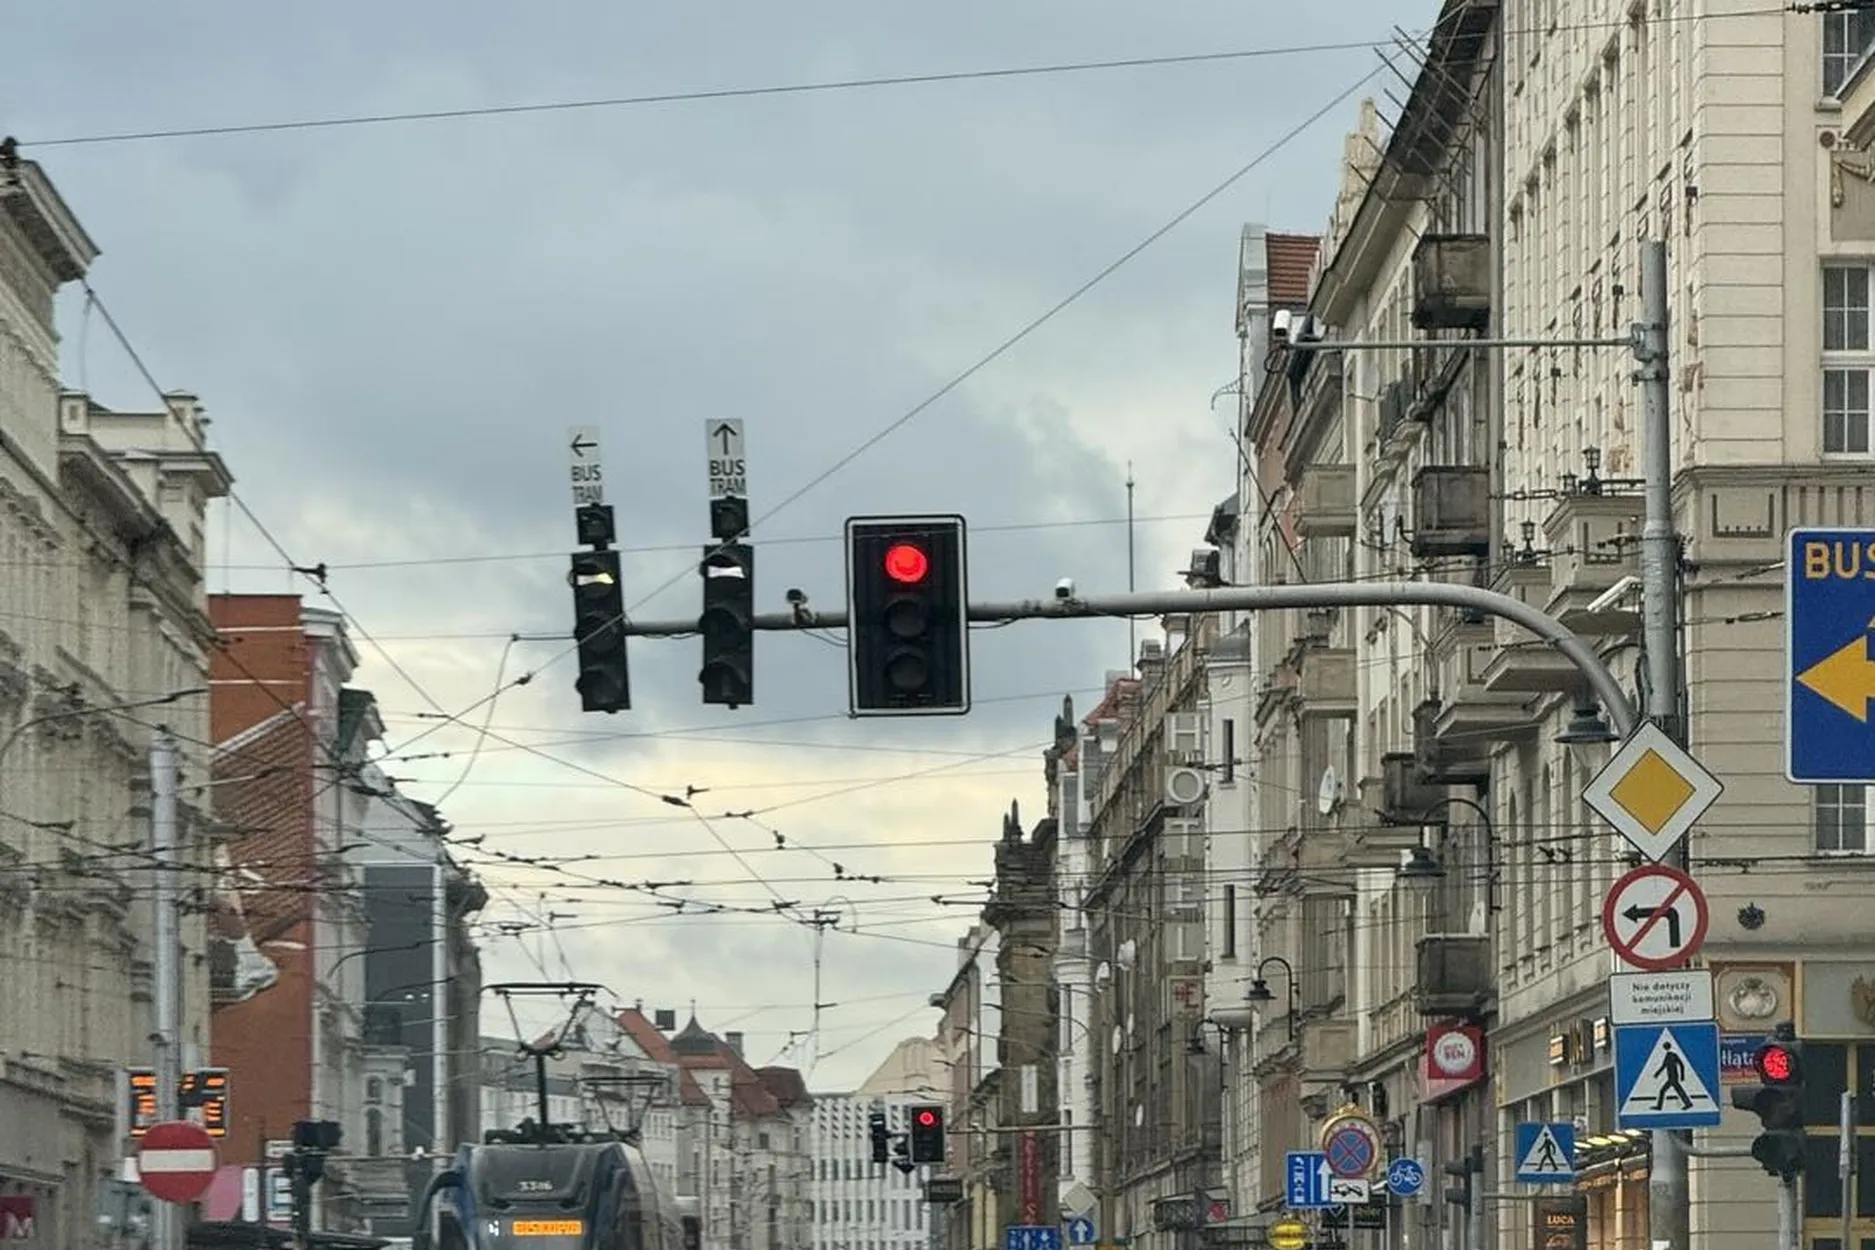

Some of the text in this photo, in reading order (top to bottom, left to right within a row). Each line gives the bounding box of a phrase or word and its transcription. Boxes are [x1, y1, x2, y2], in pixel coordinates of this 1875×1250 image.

[571, 464, 602, 482] BUS
[709, 459, 745, 476] BUS
[572, 485, 603, 503] TRAM
[709, 478, 747, 495] TRAM
[1168, 714, 1204, 961] HOTEL
[1632, 982, 1690, 992] Nie dotyczy
